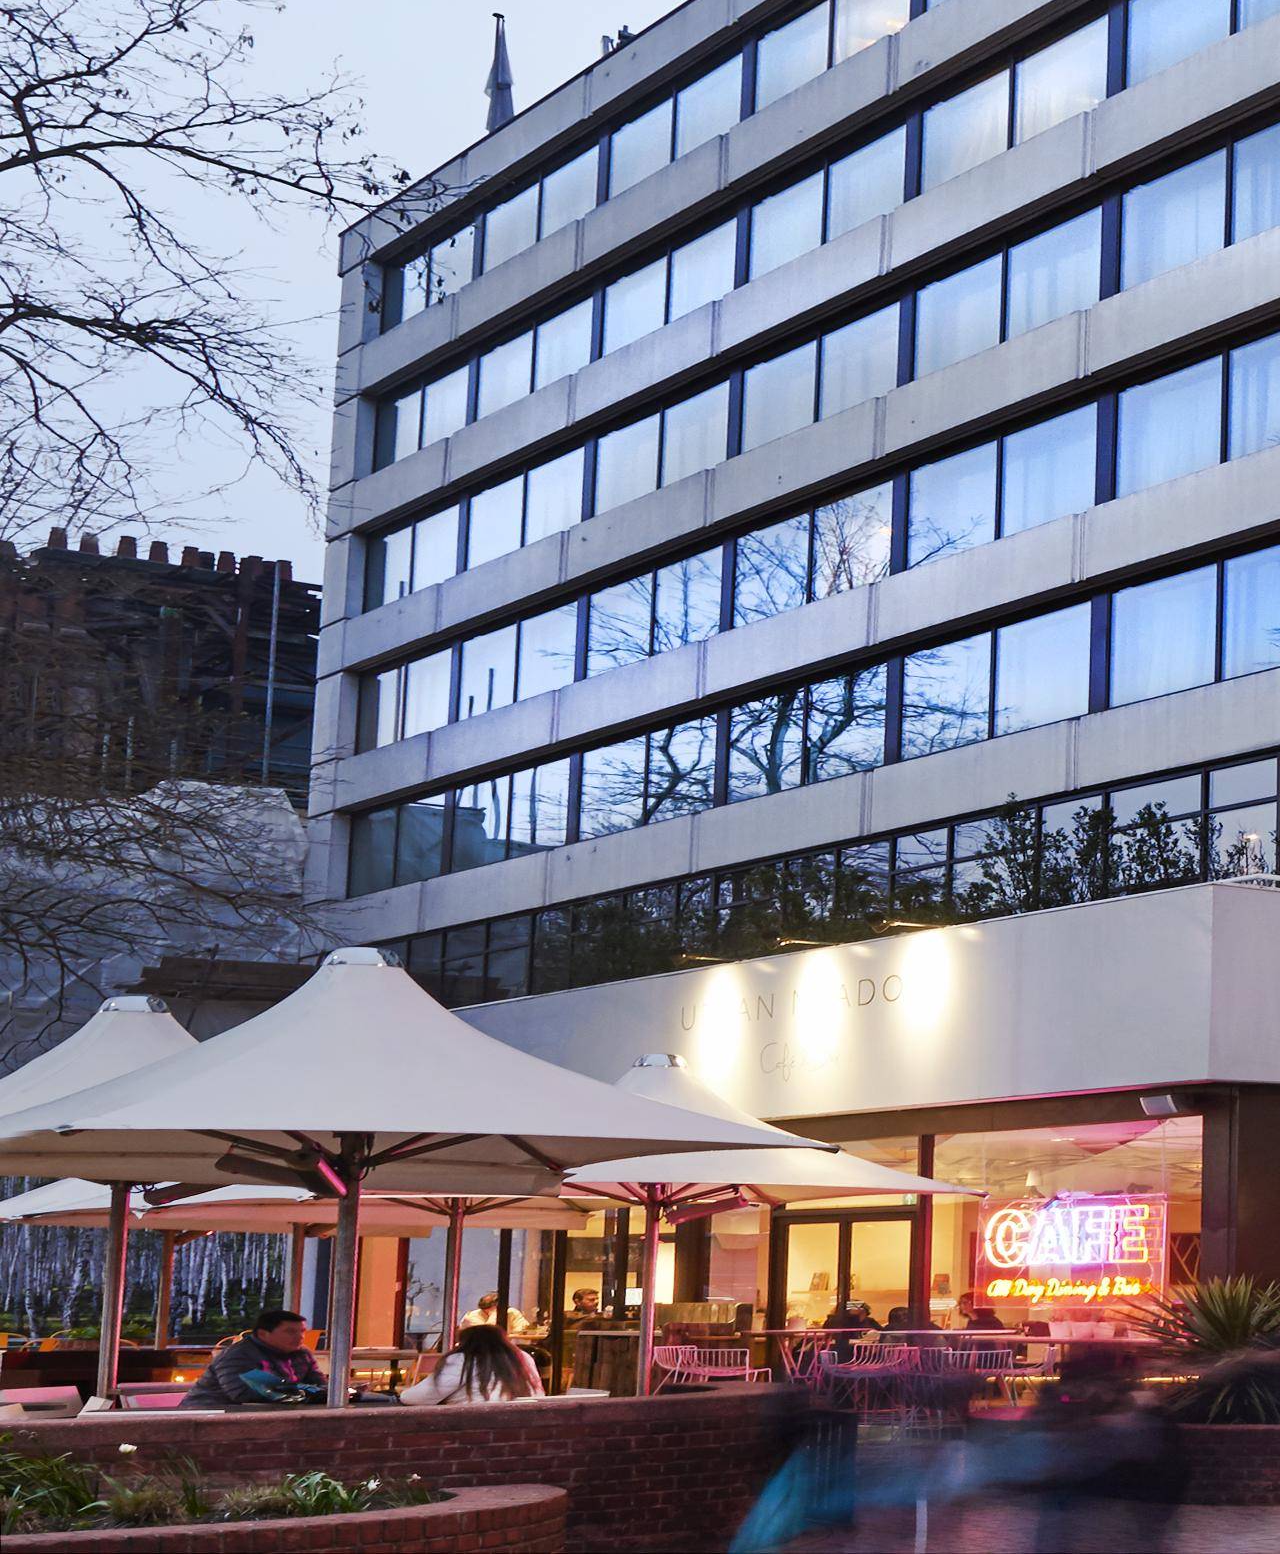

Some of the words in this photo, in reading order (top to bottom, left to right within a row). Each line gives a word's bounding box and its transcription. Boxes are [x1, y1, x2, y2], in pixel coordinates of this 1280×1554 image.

[681, 993, 774, 1031] UAN
[985, 1203, 1150, 1268] CAFE
[1045, 1277, 1097, 1303] Dining
